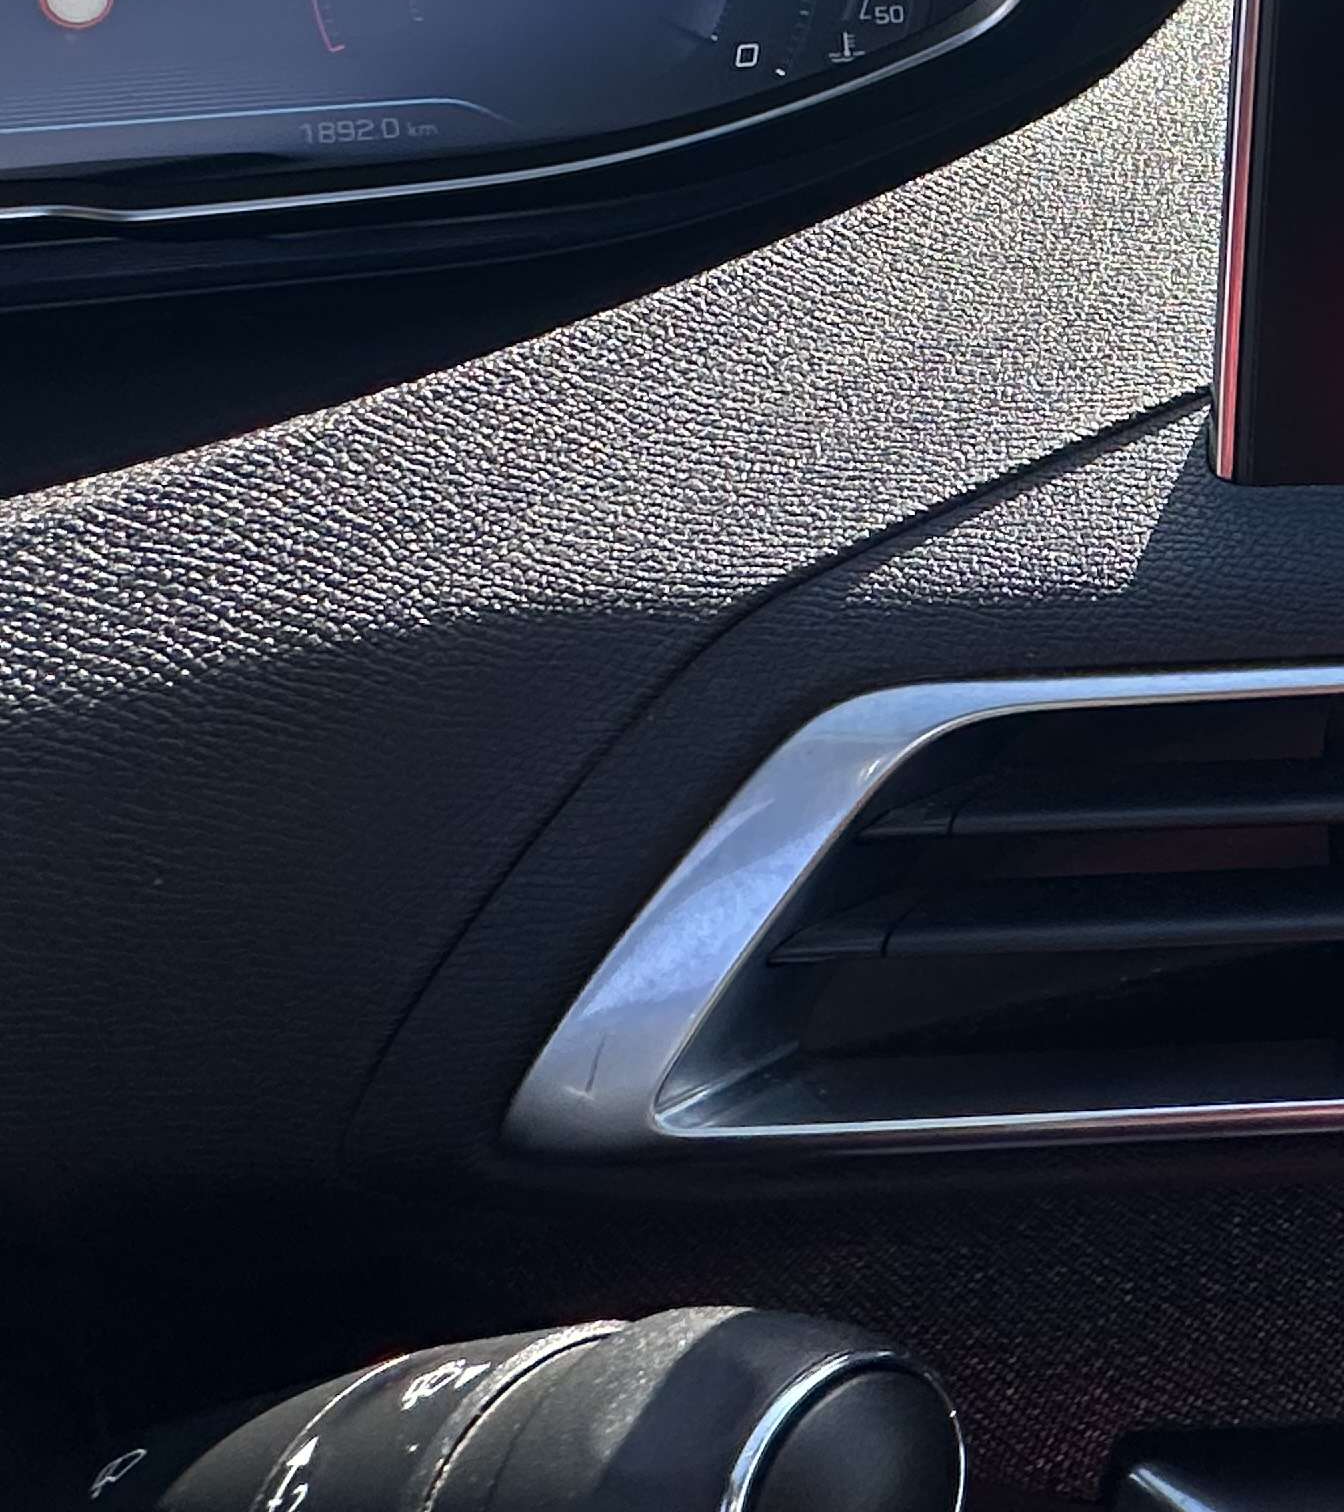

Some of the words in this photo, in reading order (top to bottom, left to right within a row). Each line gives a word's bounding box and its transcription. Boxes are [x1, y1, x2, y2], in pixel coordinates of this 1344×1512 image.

[874, 5, 904, 24] 50
[735, 43, 760, 69] 0
[405, 122, 439, 137] km
